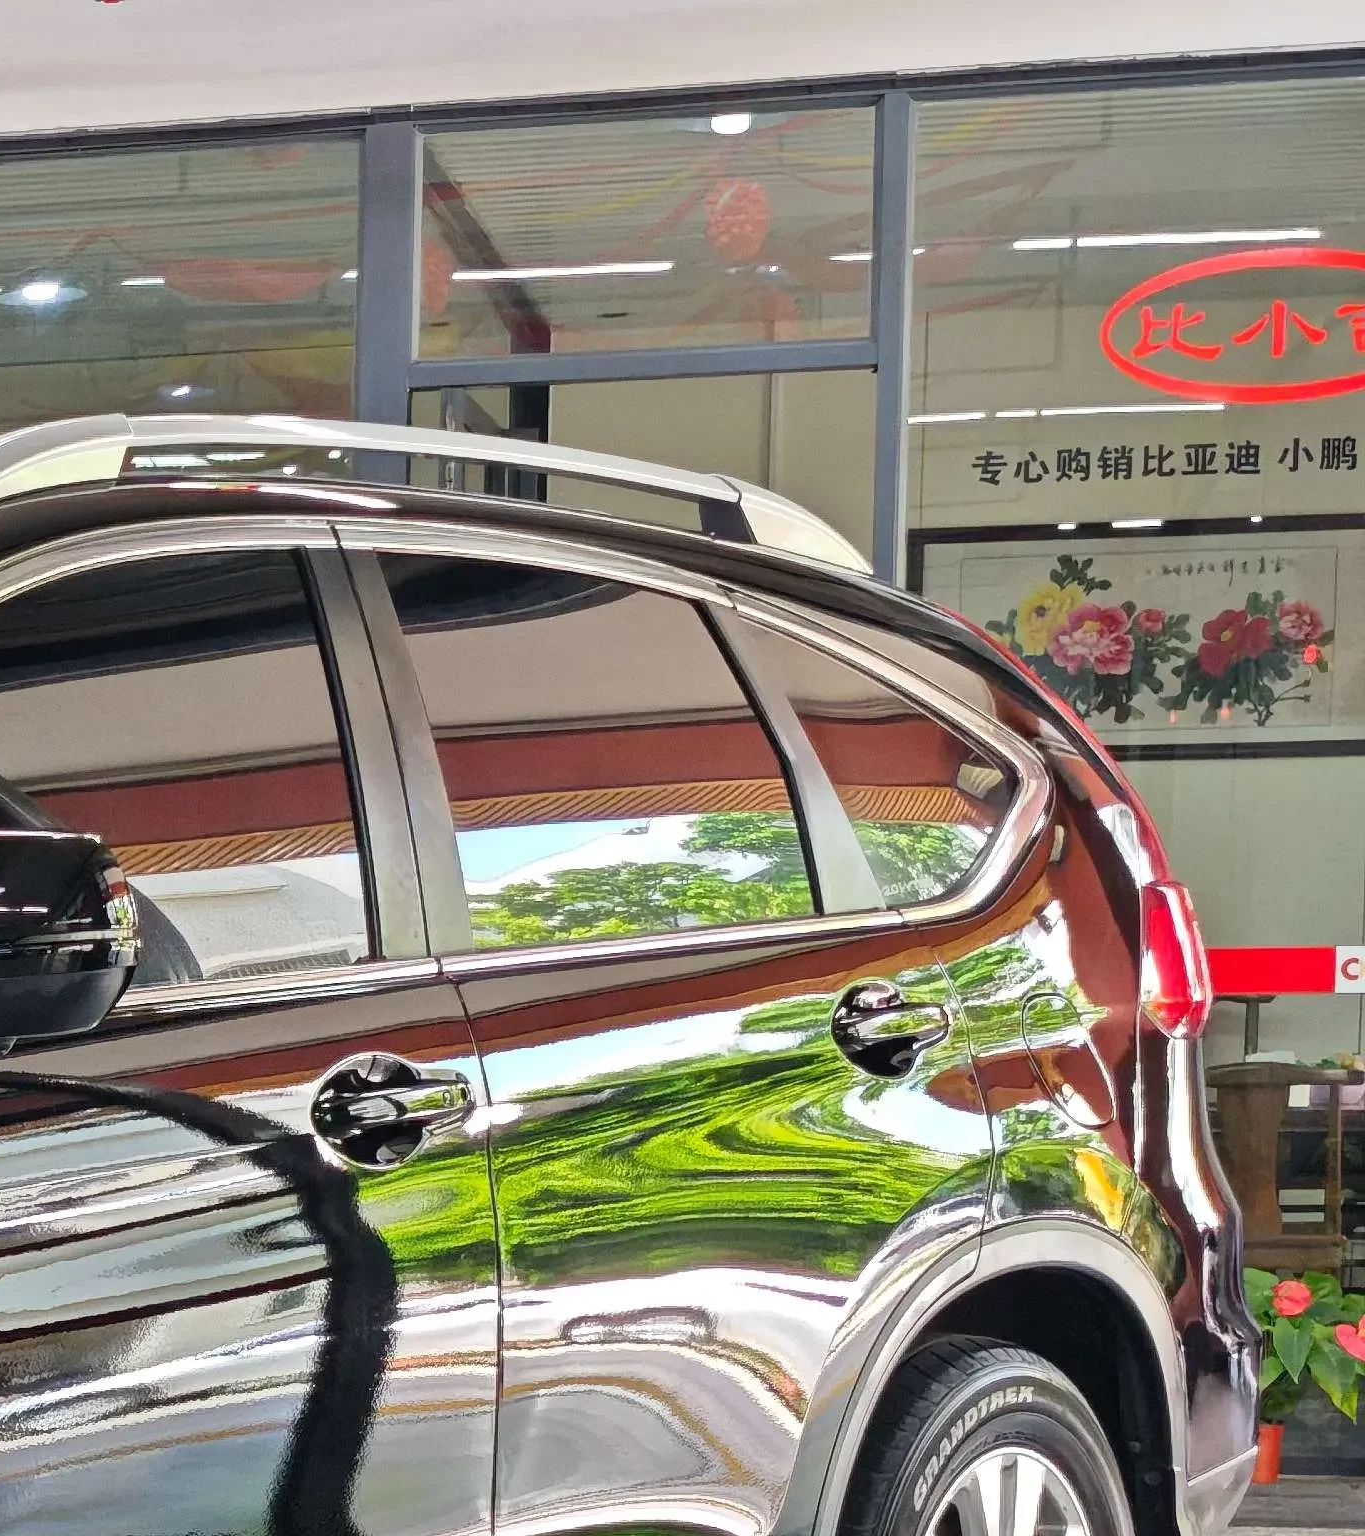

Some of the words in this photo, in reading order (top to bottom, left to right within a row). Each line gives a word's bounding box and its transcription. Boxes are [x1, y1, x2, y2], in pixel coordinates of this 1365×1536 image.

[971, 440, 1261, 486] 专心购销比亚迪
[1277, 435, 1358, 473] 小鹏
[1340, 957, 1365, 981] C
[913, 1385, 1035, 1512] GRANDTREK
